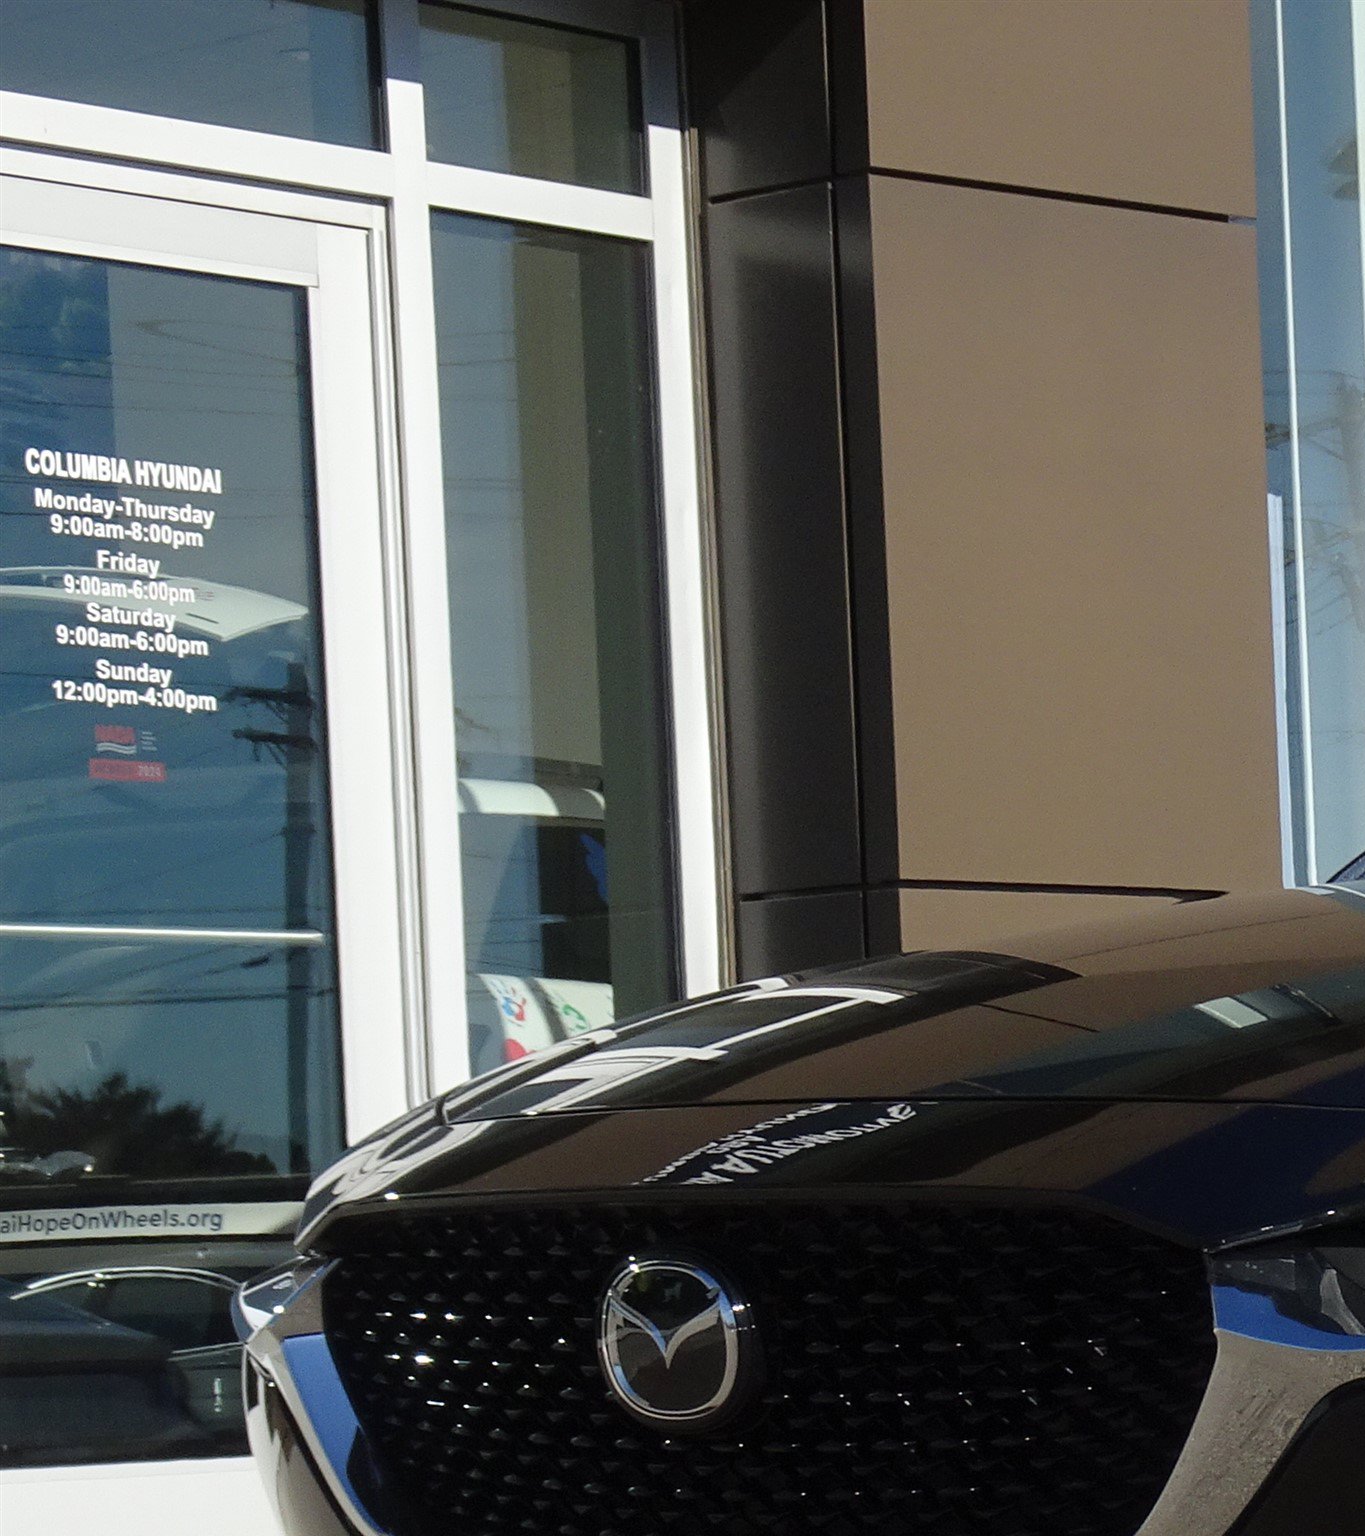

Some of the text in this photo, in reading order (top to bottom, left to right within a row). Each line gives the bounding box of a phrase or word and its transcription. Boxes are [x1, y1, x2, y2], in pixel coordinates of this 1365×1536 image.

[25, 447, 222, 494] COLUMBIA HYUNDAI
[34, 487, 215, 529] Monday-Thursday
[50, 514, 204, 548] 9:00am-8:00pm
[97, 549, 160, 579] Friday
[64, 574, 196, 606] 9:00am-6:00pm
[86, 602, 176, 633] Saturday
[55, 624, 209, 657] 9:00am-6:00pm
[96, 659, 172, 688] Sunday
[52, 680, 217, 713] 12:00pm-4:00pm
